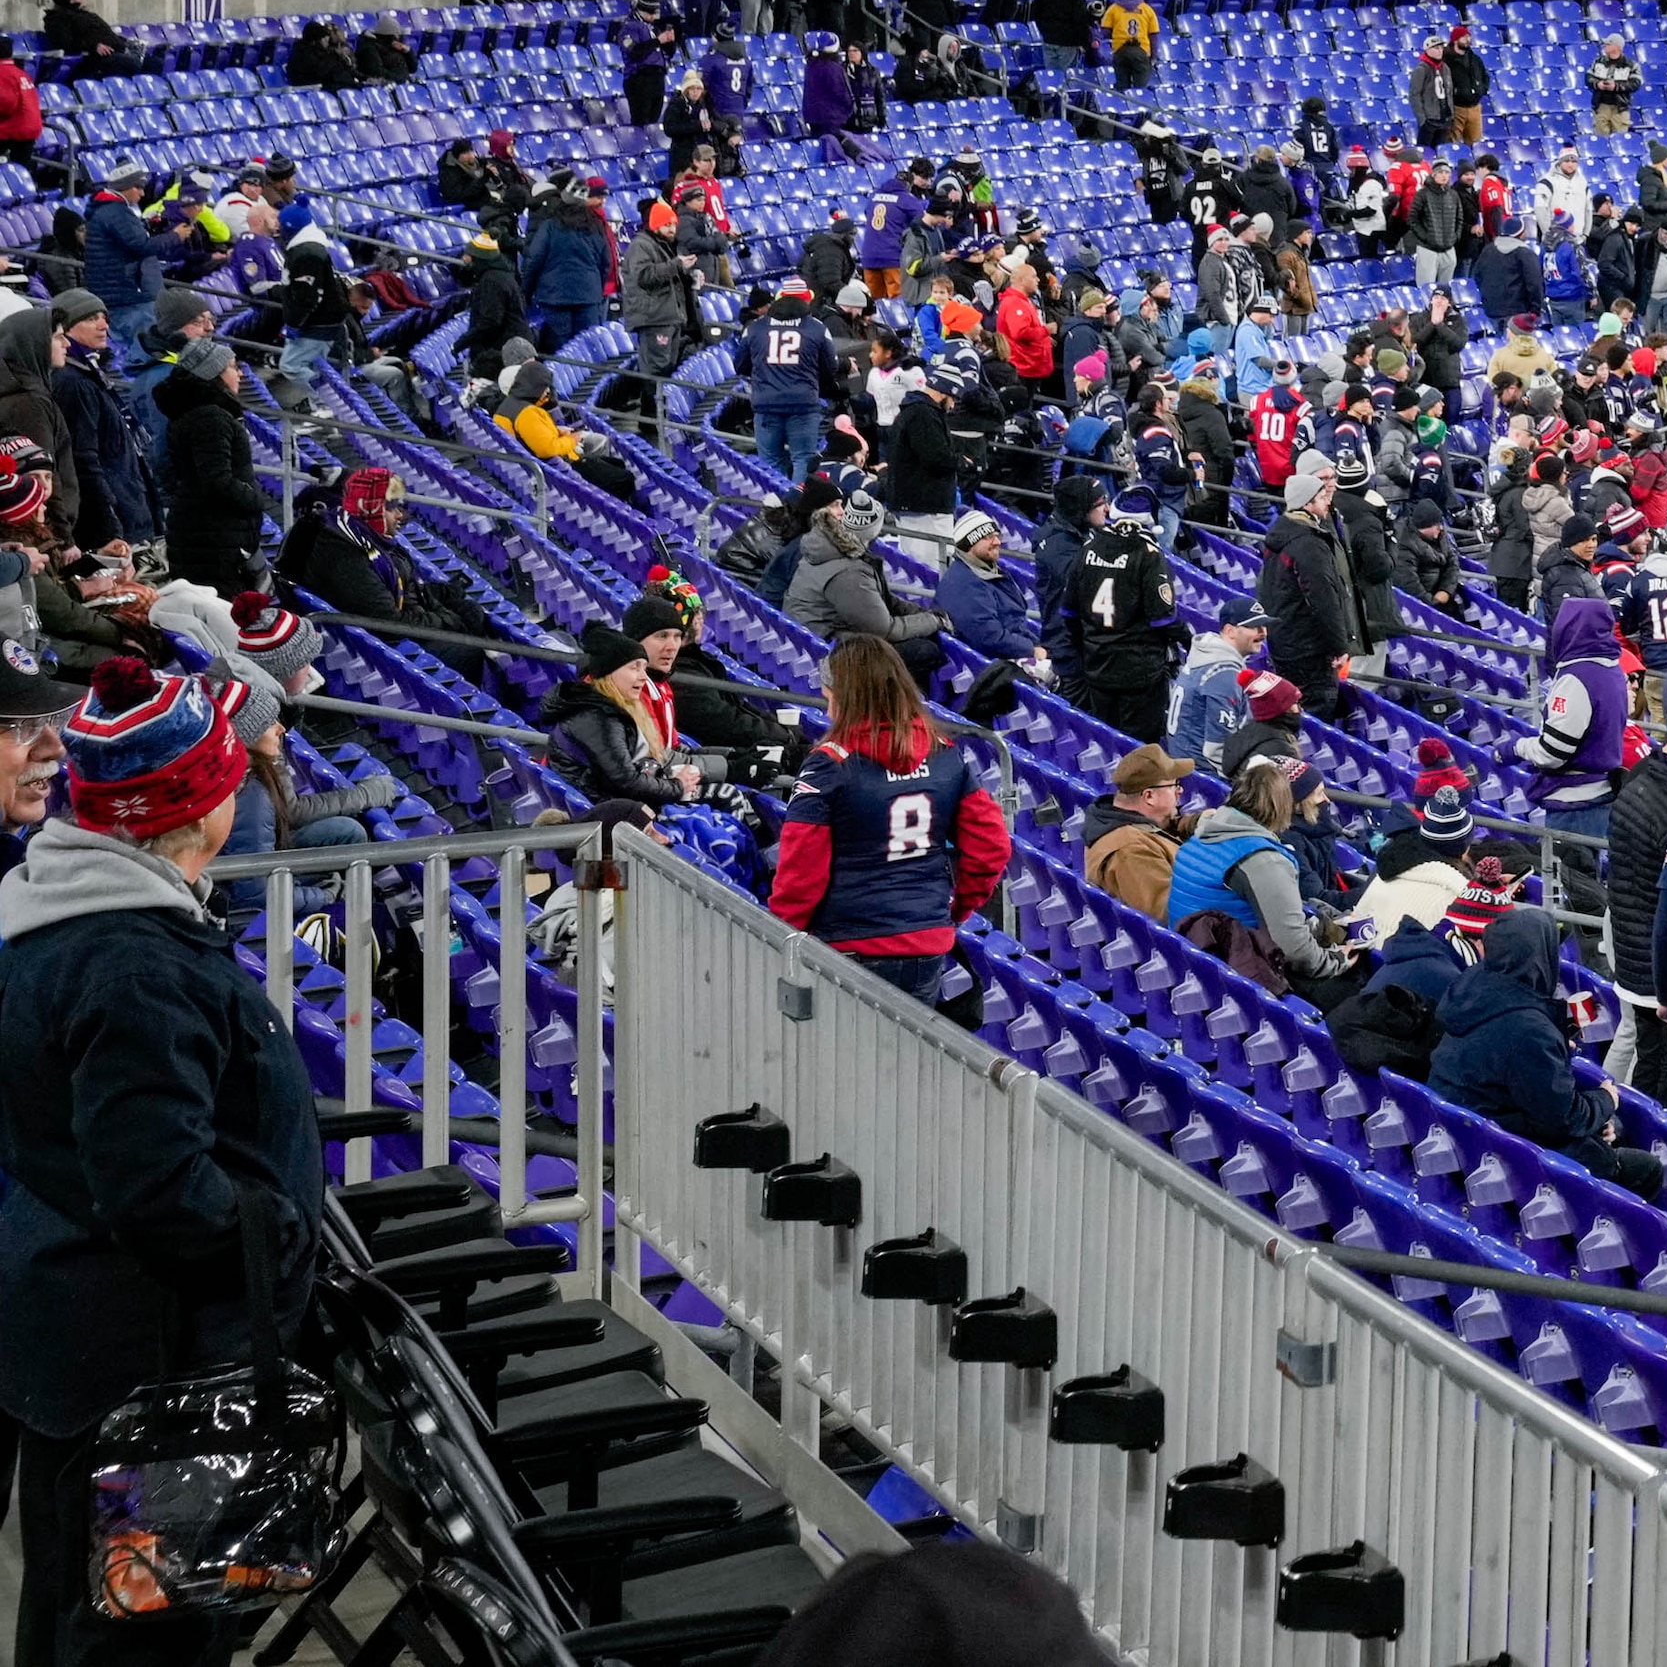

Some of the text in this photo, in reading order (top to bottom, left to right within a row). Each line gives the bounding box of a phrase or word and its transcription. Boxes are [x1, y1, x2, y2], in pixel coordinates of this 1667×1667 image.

[731, 68, 741, 94] 8
[1310, 130, 1330, 153] 12
[872, 194, 899, 203] JACKSON
[1189, 196, 1217, 225] 92
[872, 203, 887, 230] 8
[767, 330, 801, 365] 12
[1260, 411, 1284, 443] 10
[966, 521, 998, 547] RAVENS
[1092, 577, 1115, 628] 4
[887, 793, 932, 862] 8
